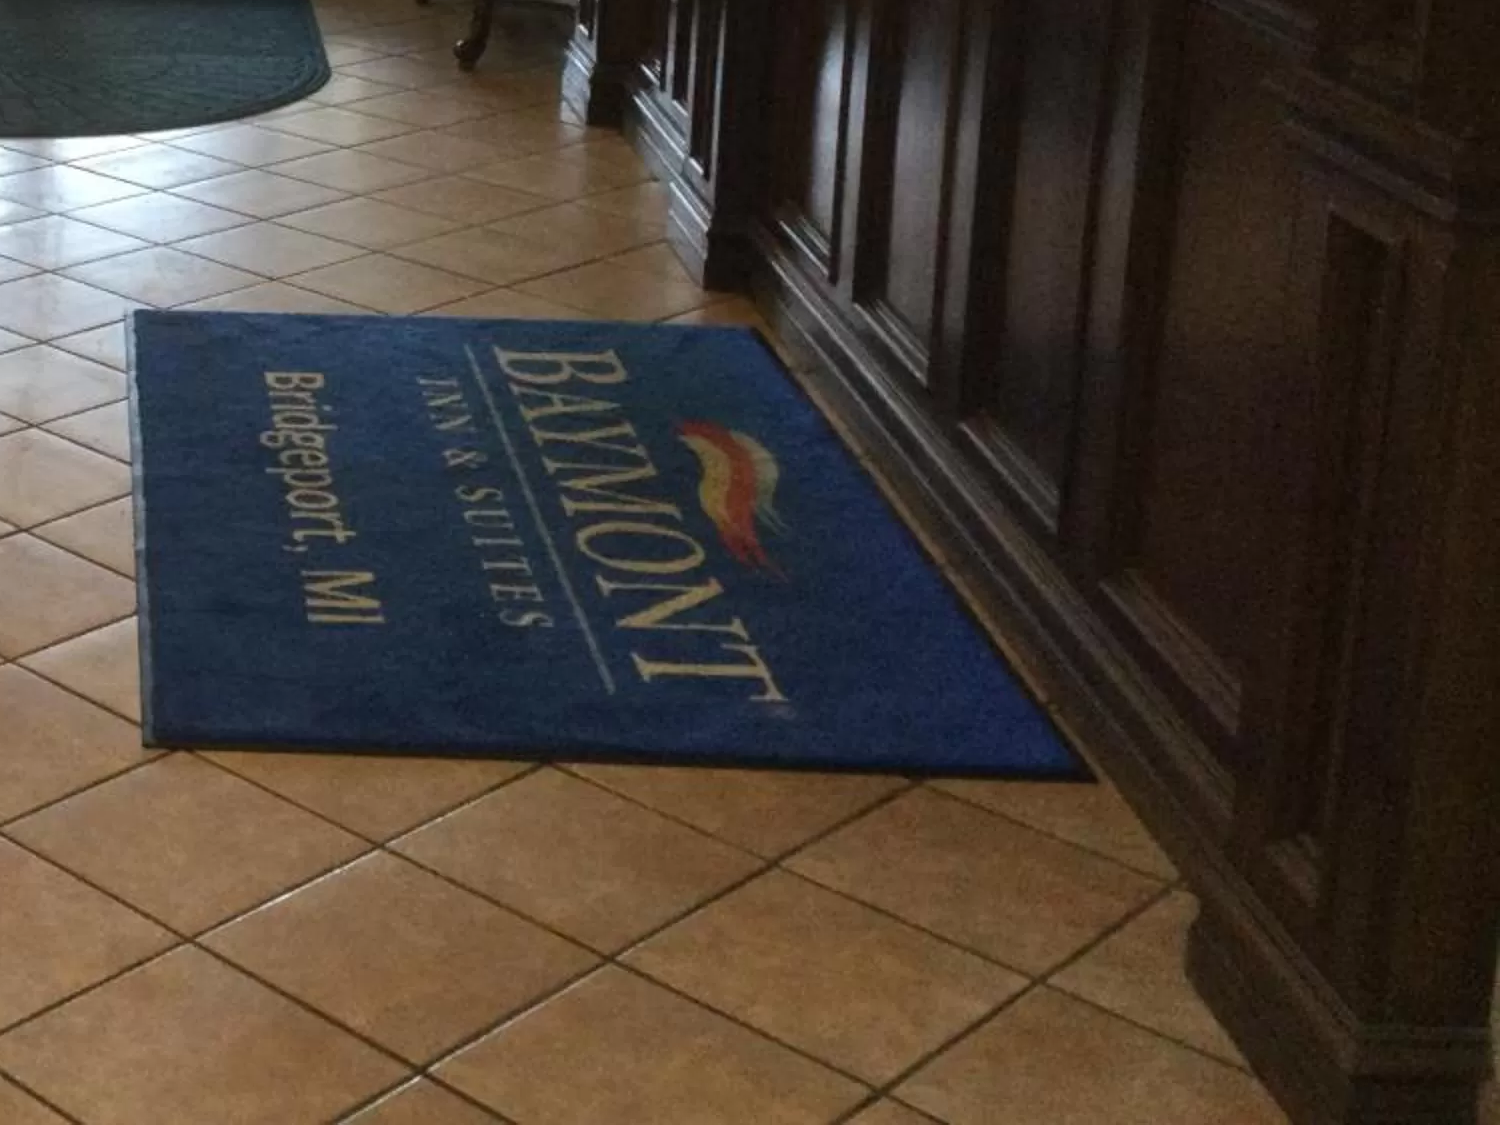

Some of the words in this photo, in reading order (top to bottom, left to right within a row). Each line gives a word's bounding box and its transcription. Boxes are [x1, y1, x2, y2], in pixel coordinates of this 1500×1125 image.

[417, 375, 471, 432] INN
[260, 371, 357, 552] Bridgeport,
[444, 449, 487, 471] &
[455, 485, 555, 629] SUITES
[493, 346, 789, 703] BAYMONT
[303, 570, 385, 624] MI
